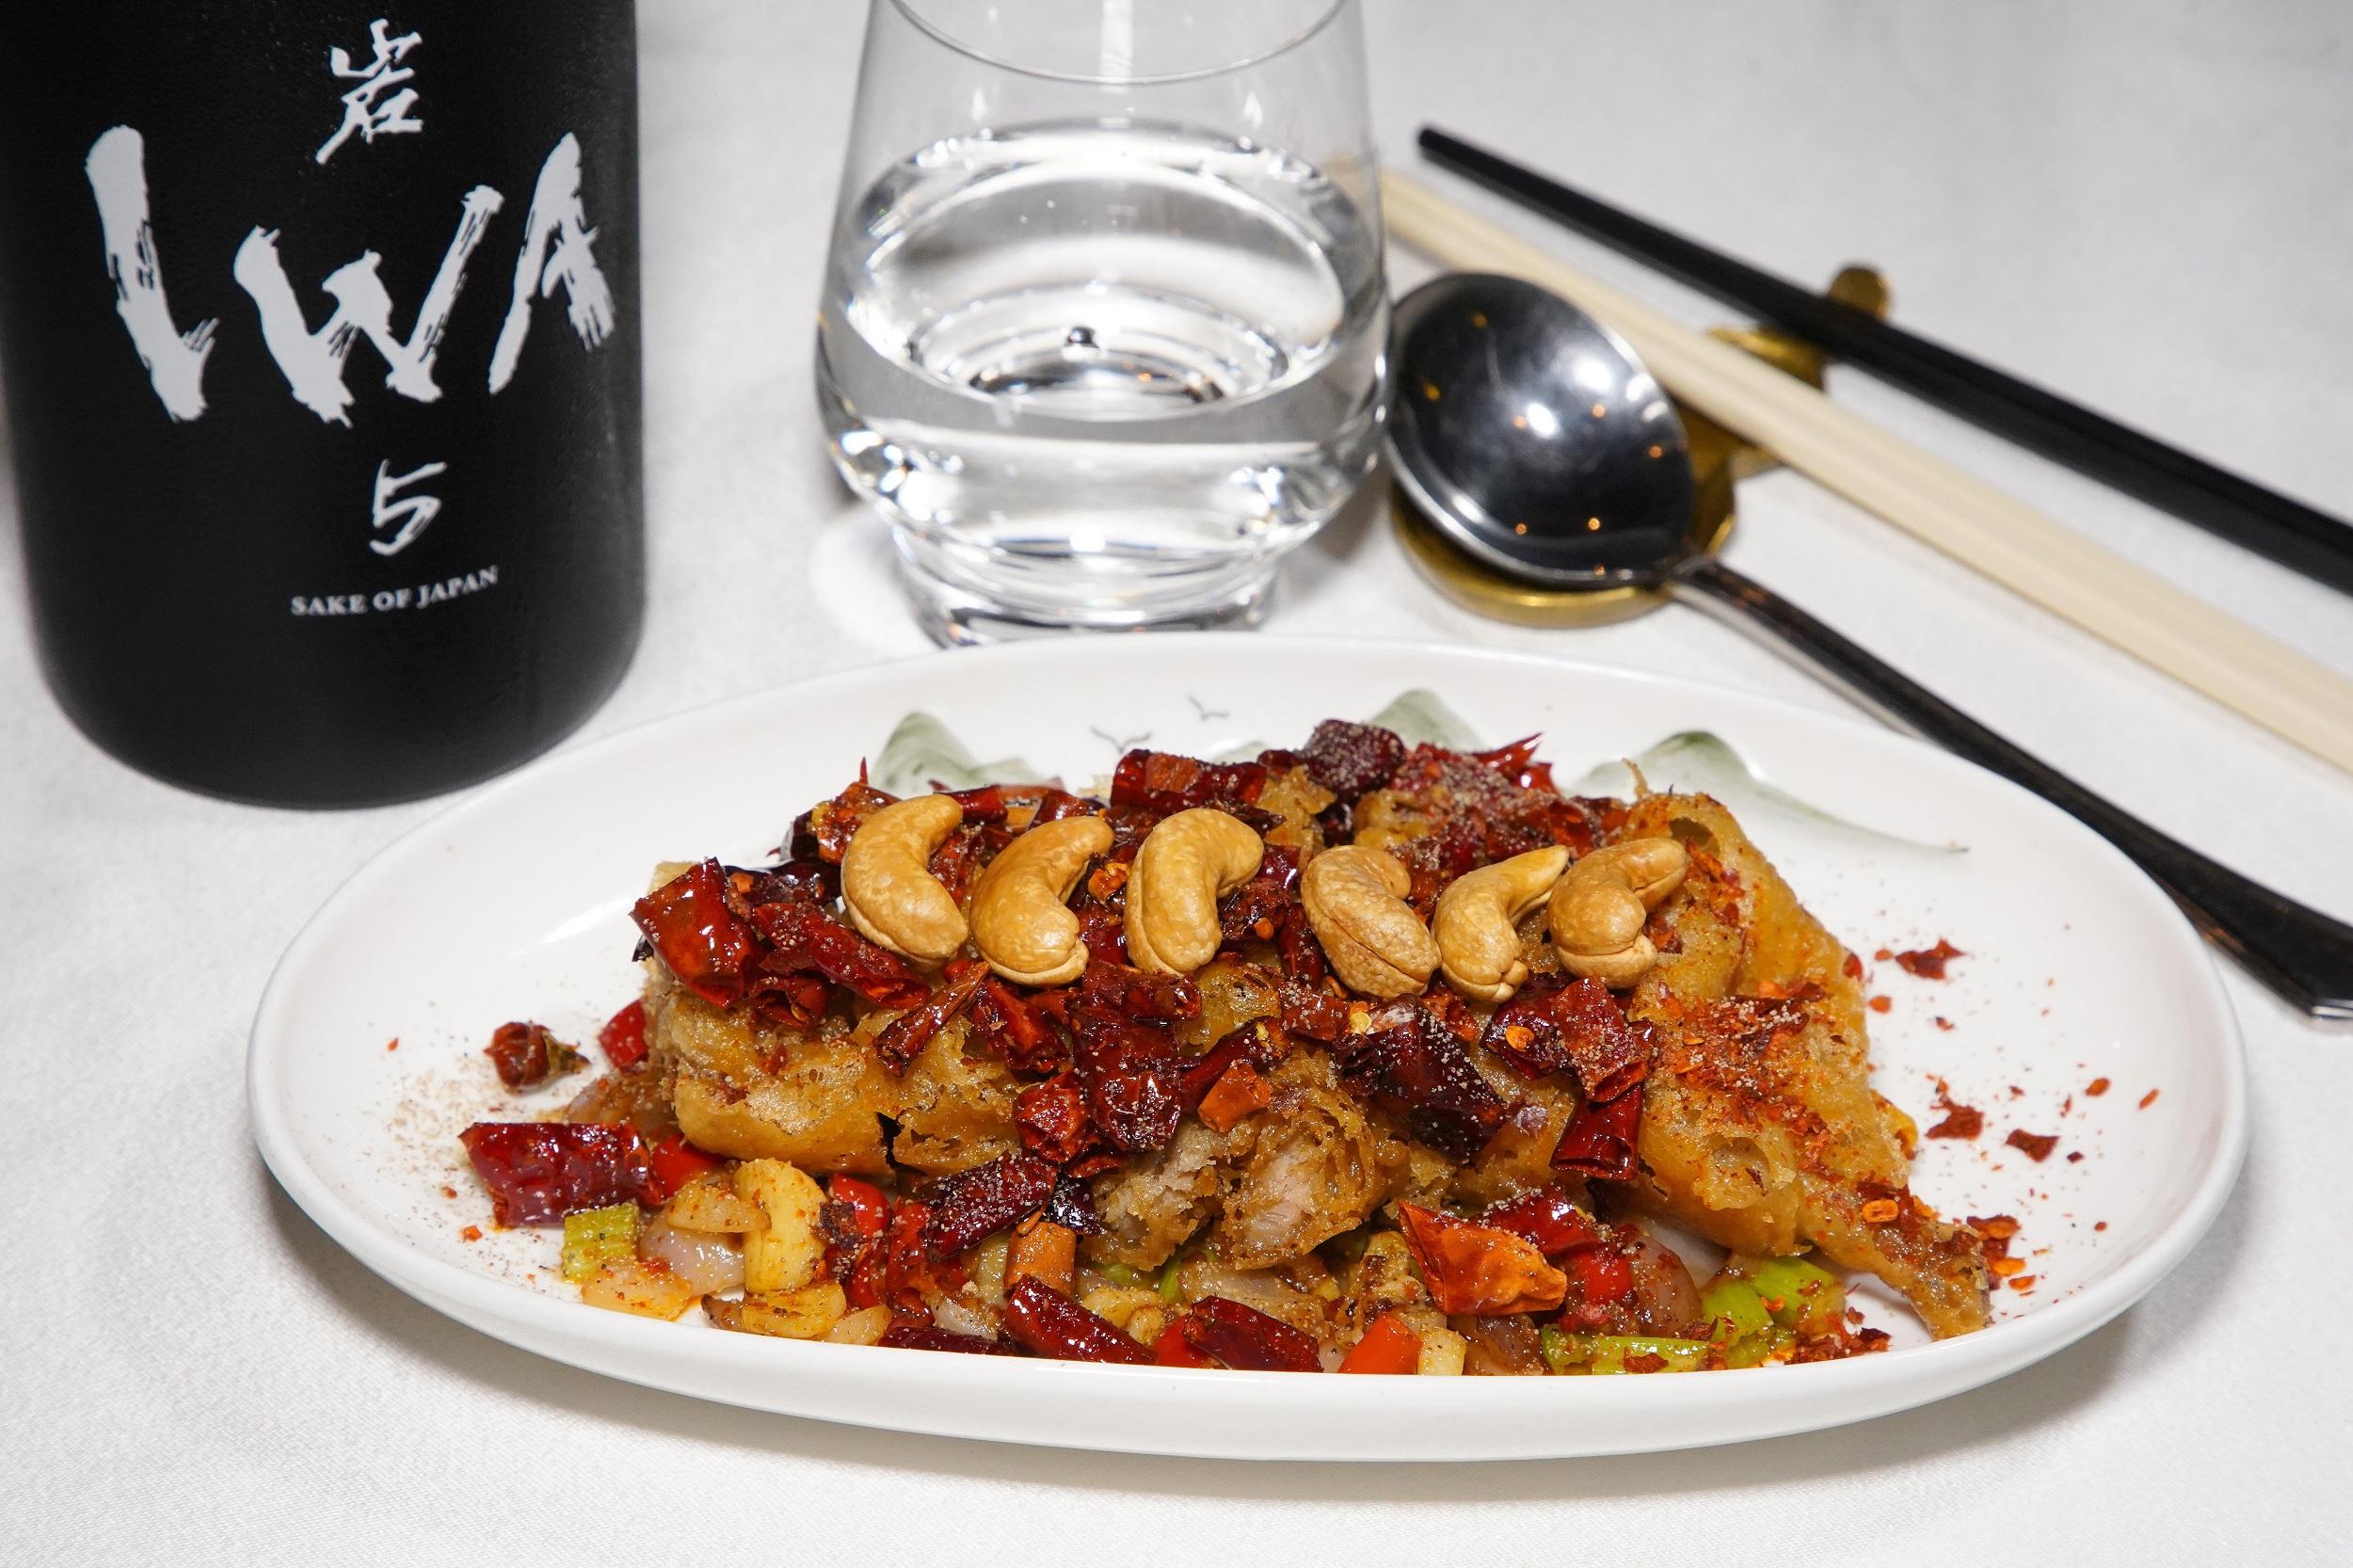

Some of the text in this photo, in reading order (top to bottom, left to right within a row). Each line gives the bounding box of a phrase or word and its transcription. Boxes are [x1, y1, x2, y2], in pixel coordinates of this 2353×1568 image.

[315, 18, 423, 165] 岩
[86, 124, 615, 428] IWA
[369, 459, 448, 556] 5
[291, 566, 500, 616] SAKE OF JAPAN
